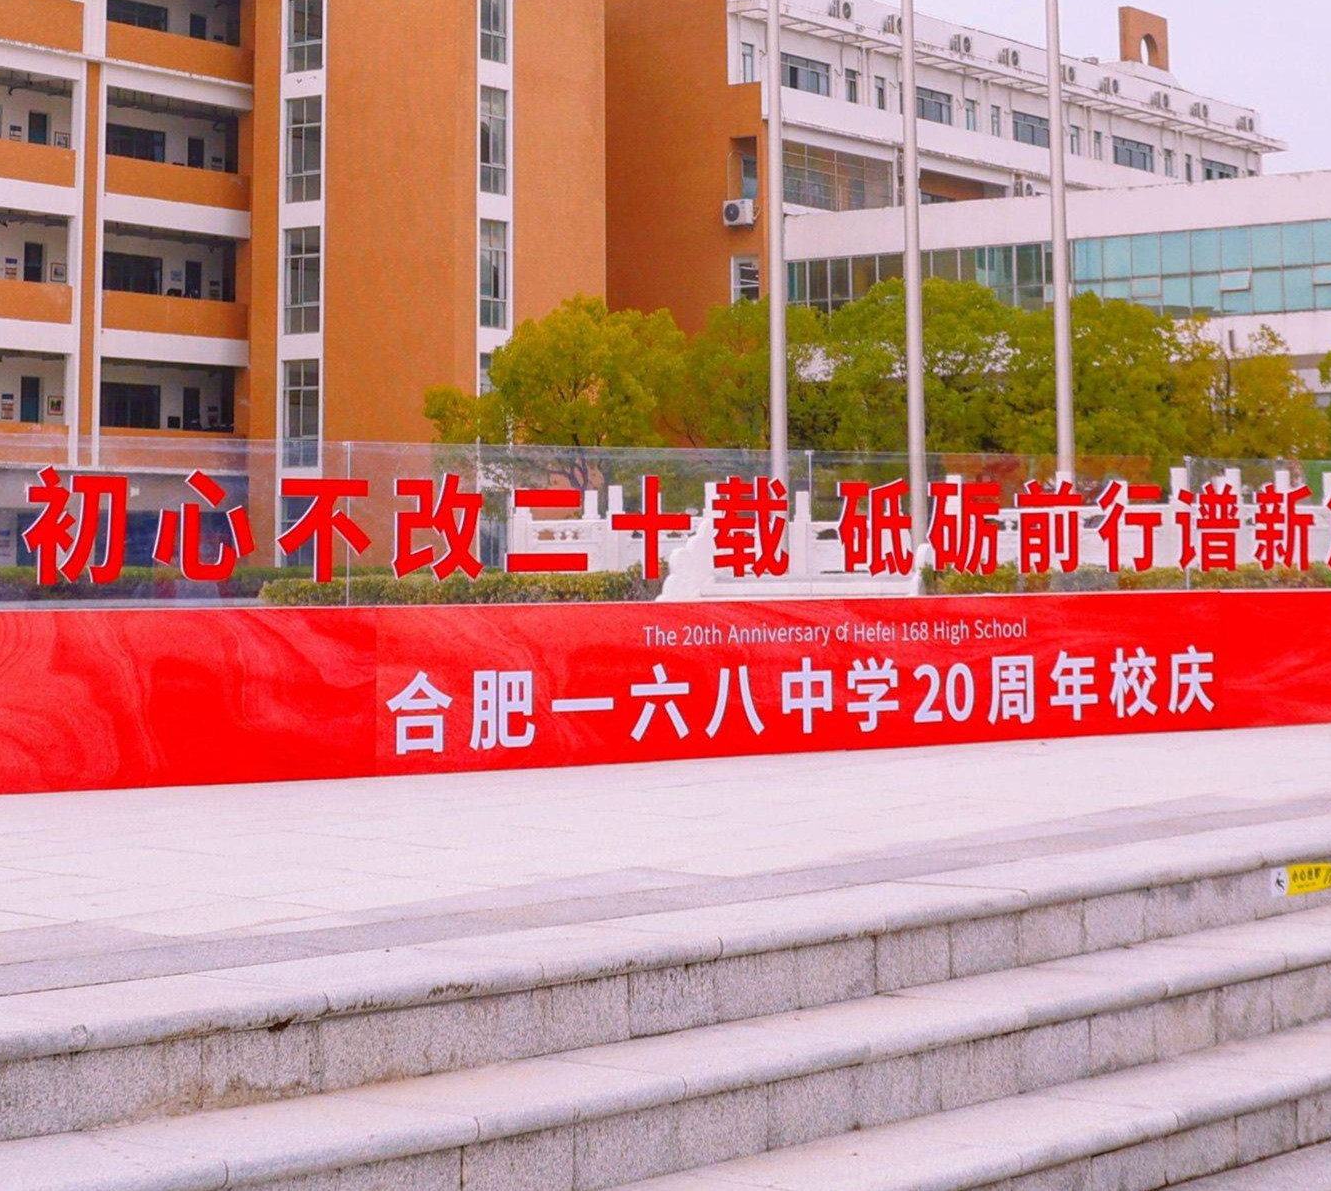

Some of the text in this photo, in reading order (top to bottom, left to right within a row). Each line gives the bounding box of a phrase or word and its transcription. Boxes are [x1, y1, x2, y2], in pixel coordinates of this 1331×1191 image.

[22, 464, 789, 585] 初心不改二十载
[643, 618, 1028, 648] The 20th Anniversary of Hefei 168 High School
[386, 646, 1216, 755] 合肥一六八中学20周年校庆
